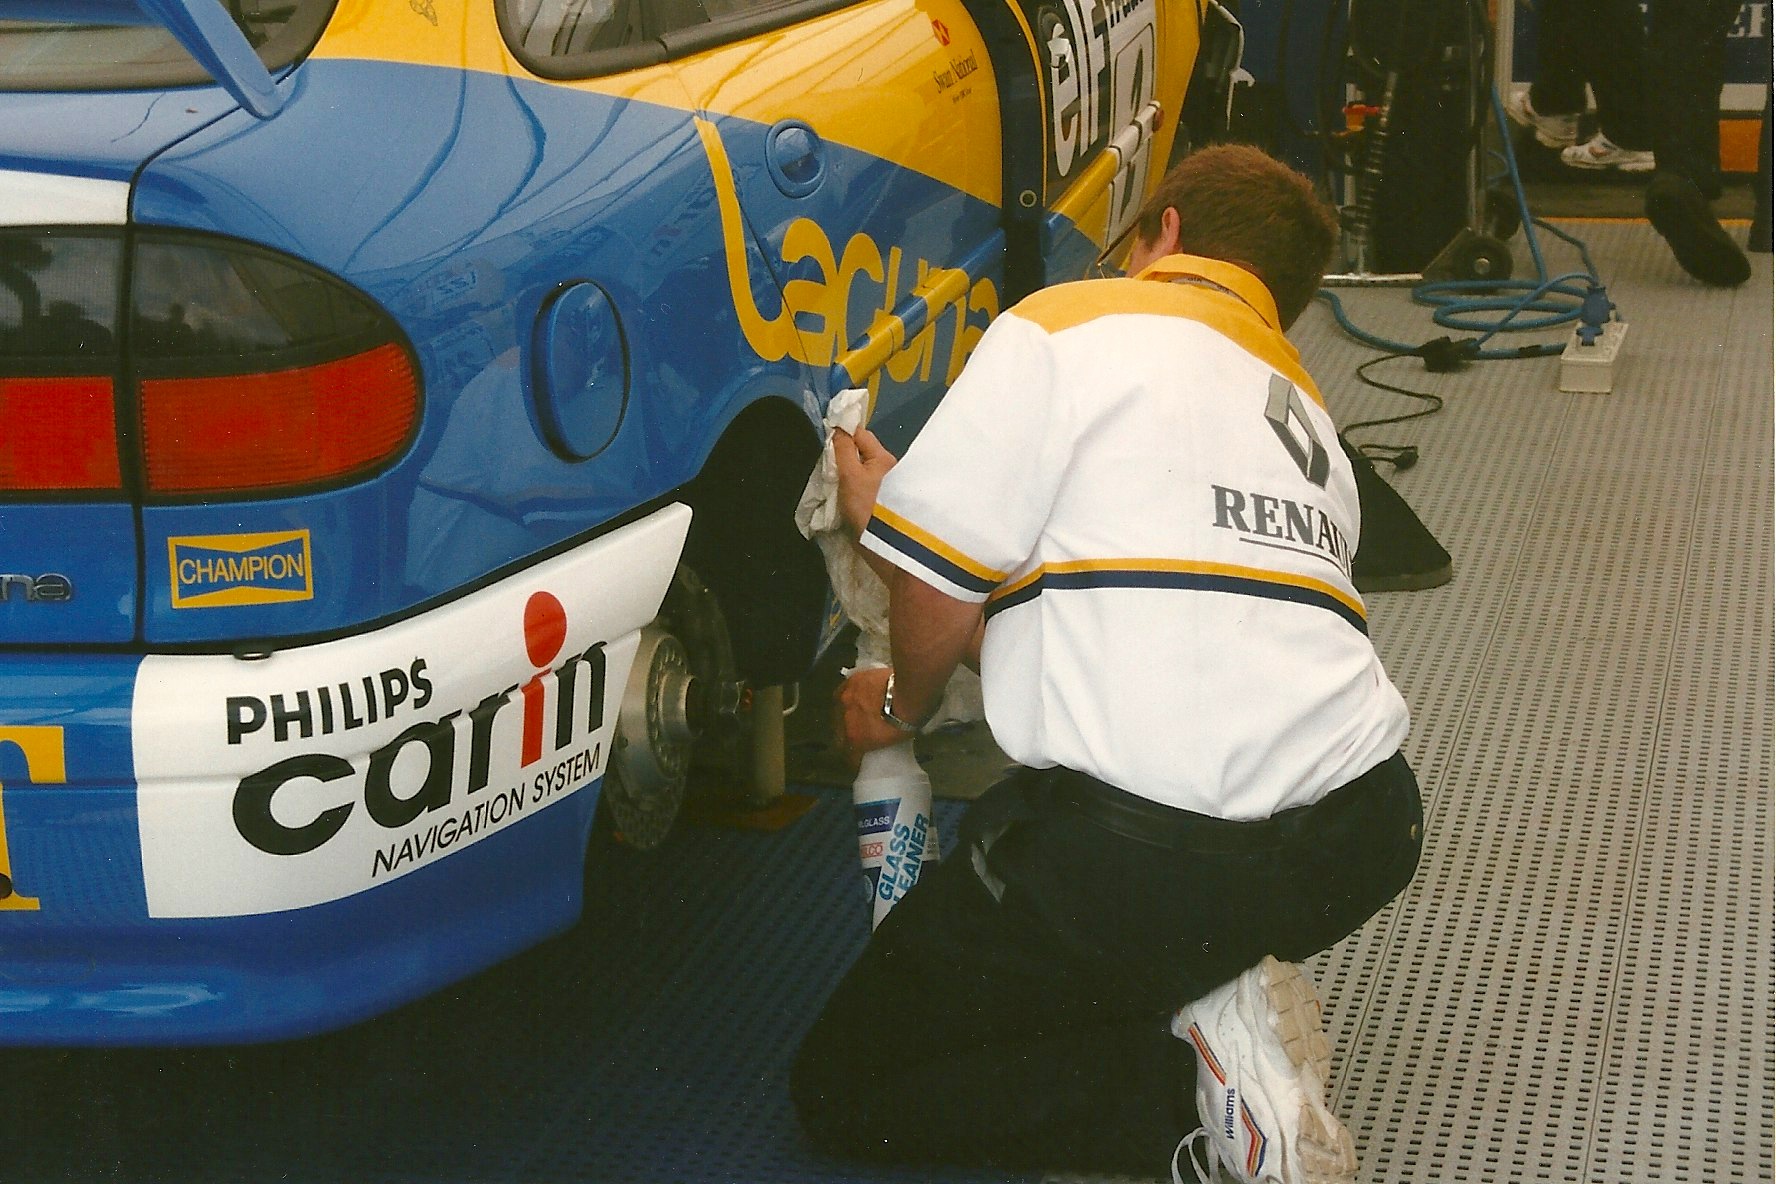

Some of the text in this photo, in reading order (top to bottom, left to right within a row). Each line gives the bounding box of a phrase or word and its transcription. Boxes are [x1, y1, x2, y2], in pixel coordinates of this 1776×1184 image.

[949, 48, 978, 80] National
[178, 553, 304, 584] CHAMPION
[226, 656, 433, 745] PHILIPS
[232, 591, 608, 856] carin
[371, 742, 601, 878] NAVIGATION SYSTEM
[878, 823, 911, 901] GLASS
[893, 812, 929, 902] EANER
[1225, 1088, 1236, 1140] Williams
